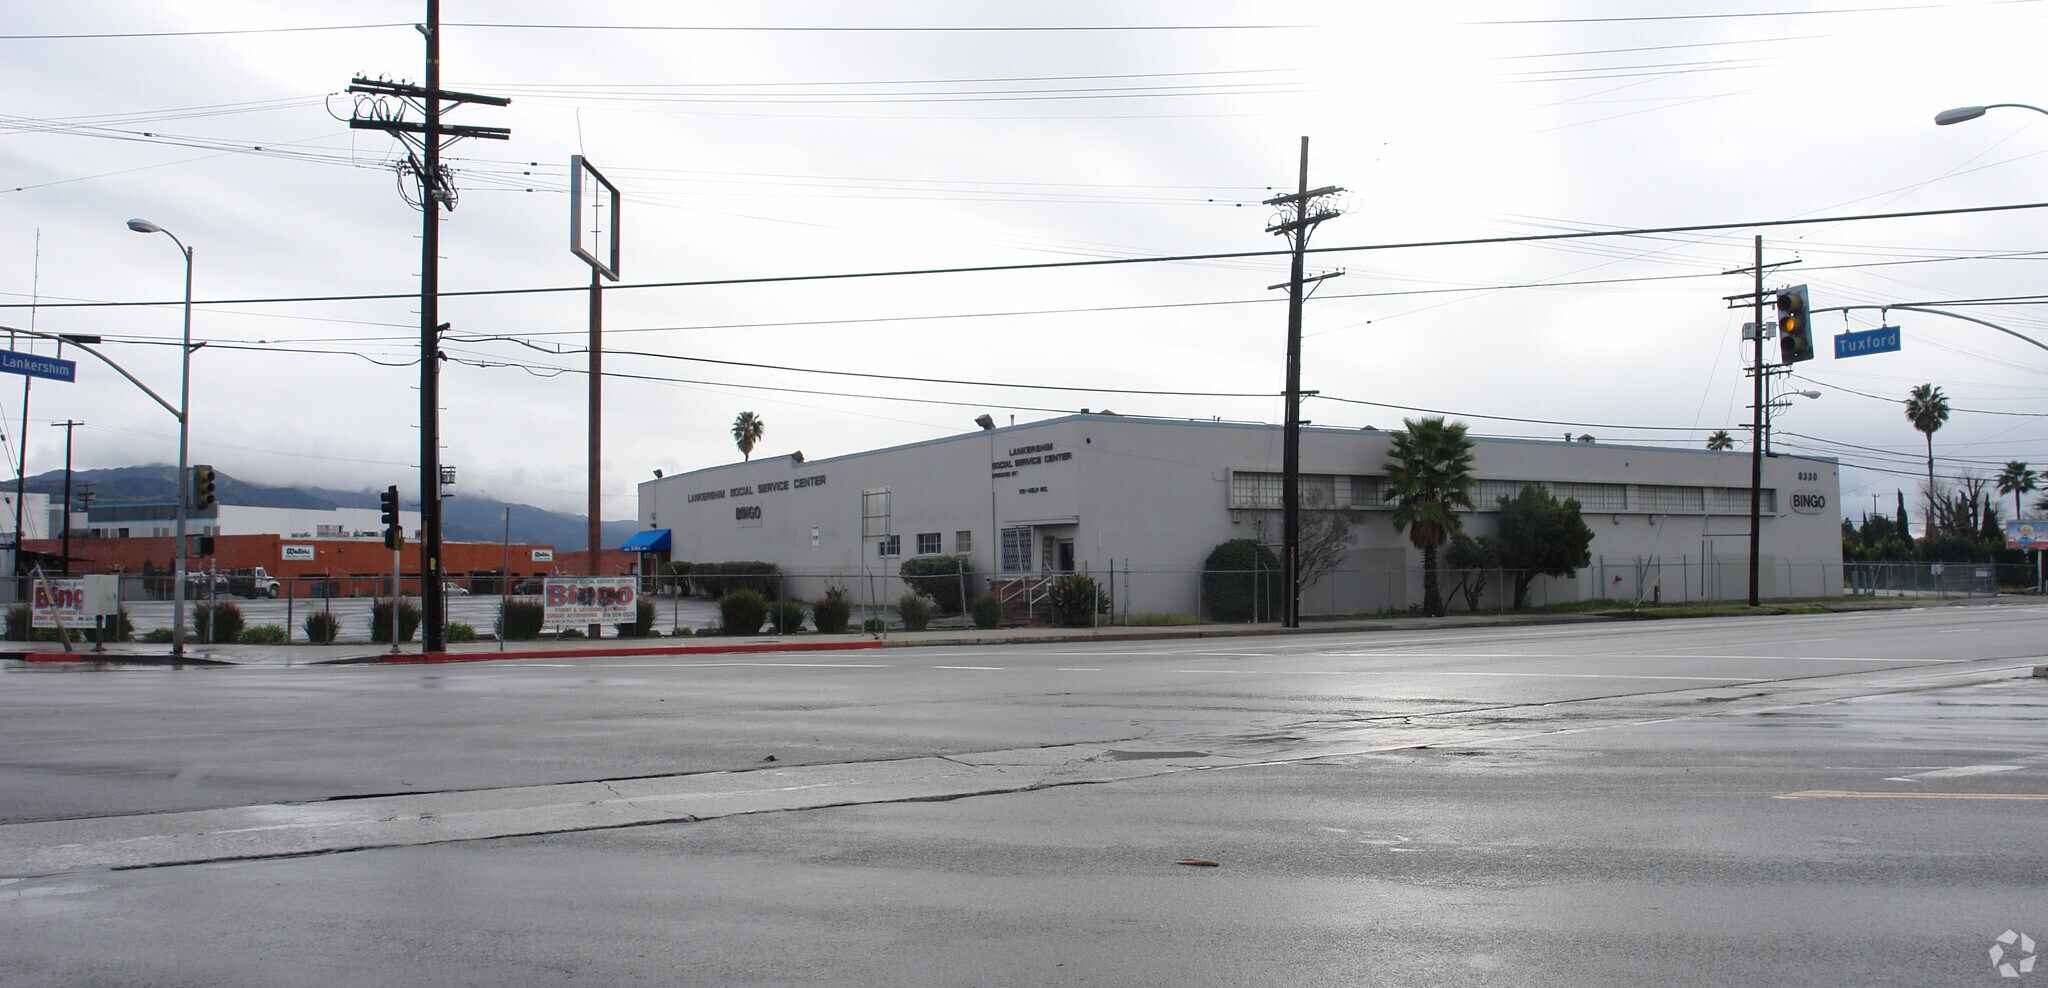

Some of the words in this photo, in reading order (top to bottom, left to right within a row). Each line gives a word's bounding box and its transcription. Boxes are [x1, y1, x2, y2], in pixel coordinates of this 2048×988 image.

[1839, 333, 1896, 352] Tuxford
[2, 354, 69, 376] Lankershim
[1009, 443, 1053, 456] LANKERSHIM
[992, 460, 1013, 470] SOCIAL
[1015, 456, 1041, 467] SERVICE
[1044, 452, 1072, 463] CENTER
[1798, 472, 1818, 481] 8330
[687, 490, 726, 503] LANKERSHIM
[730, 486, 754, 497] SOCIAL
[758, 480, 789, 494] SERVICE
[793, 475, 826, 489] CENTER
[1793, 494, 1826, 509] BINGO
[736, 505, 761, 520] BINGO
[546, 584, 634, 607] Bingo
